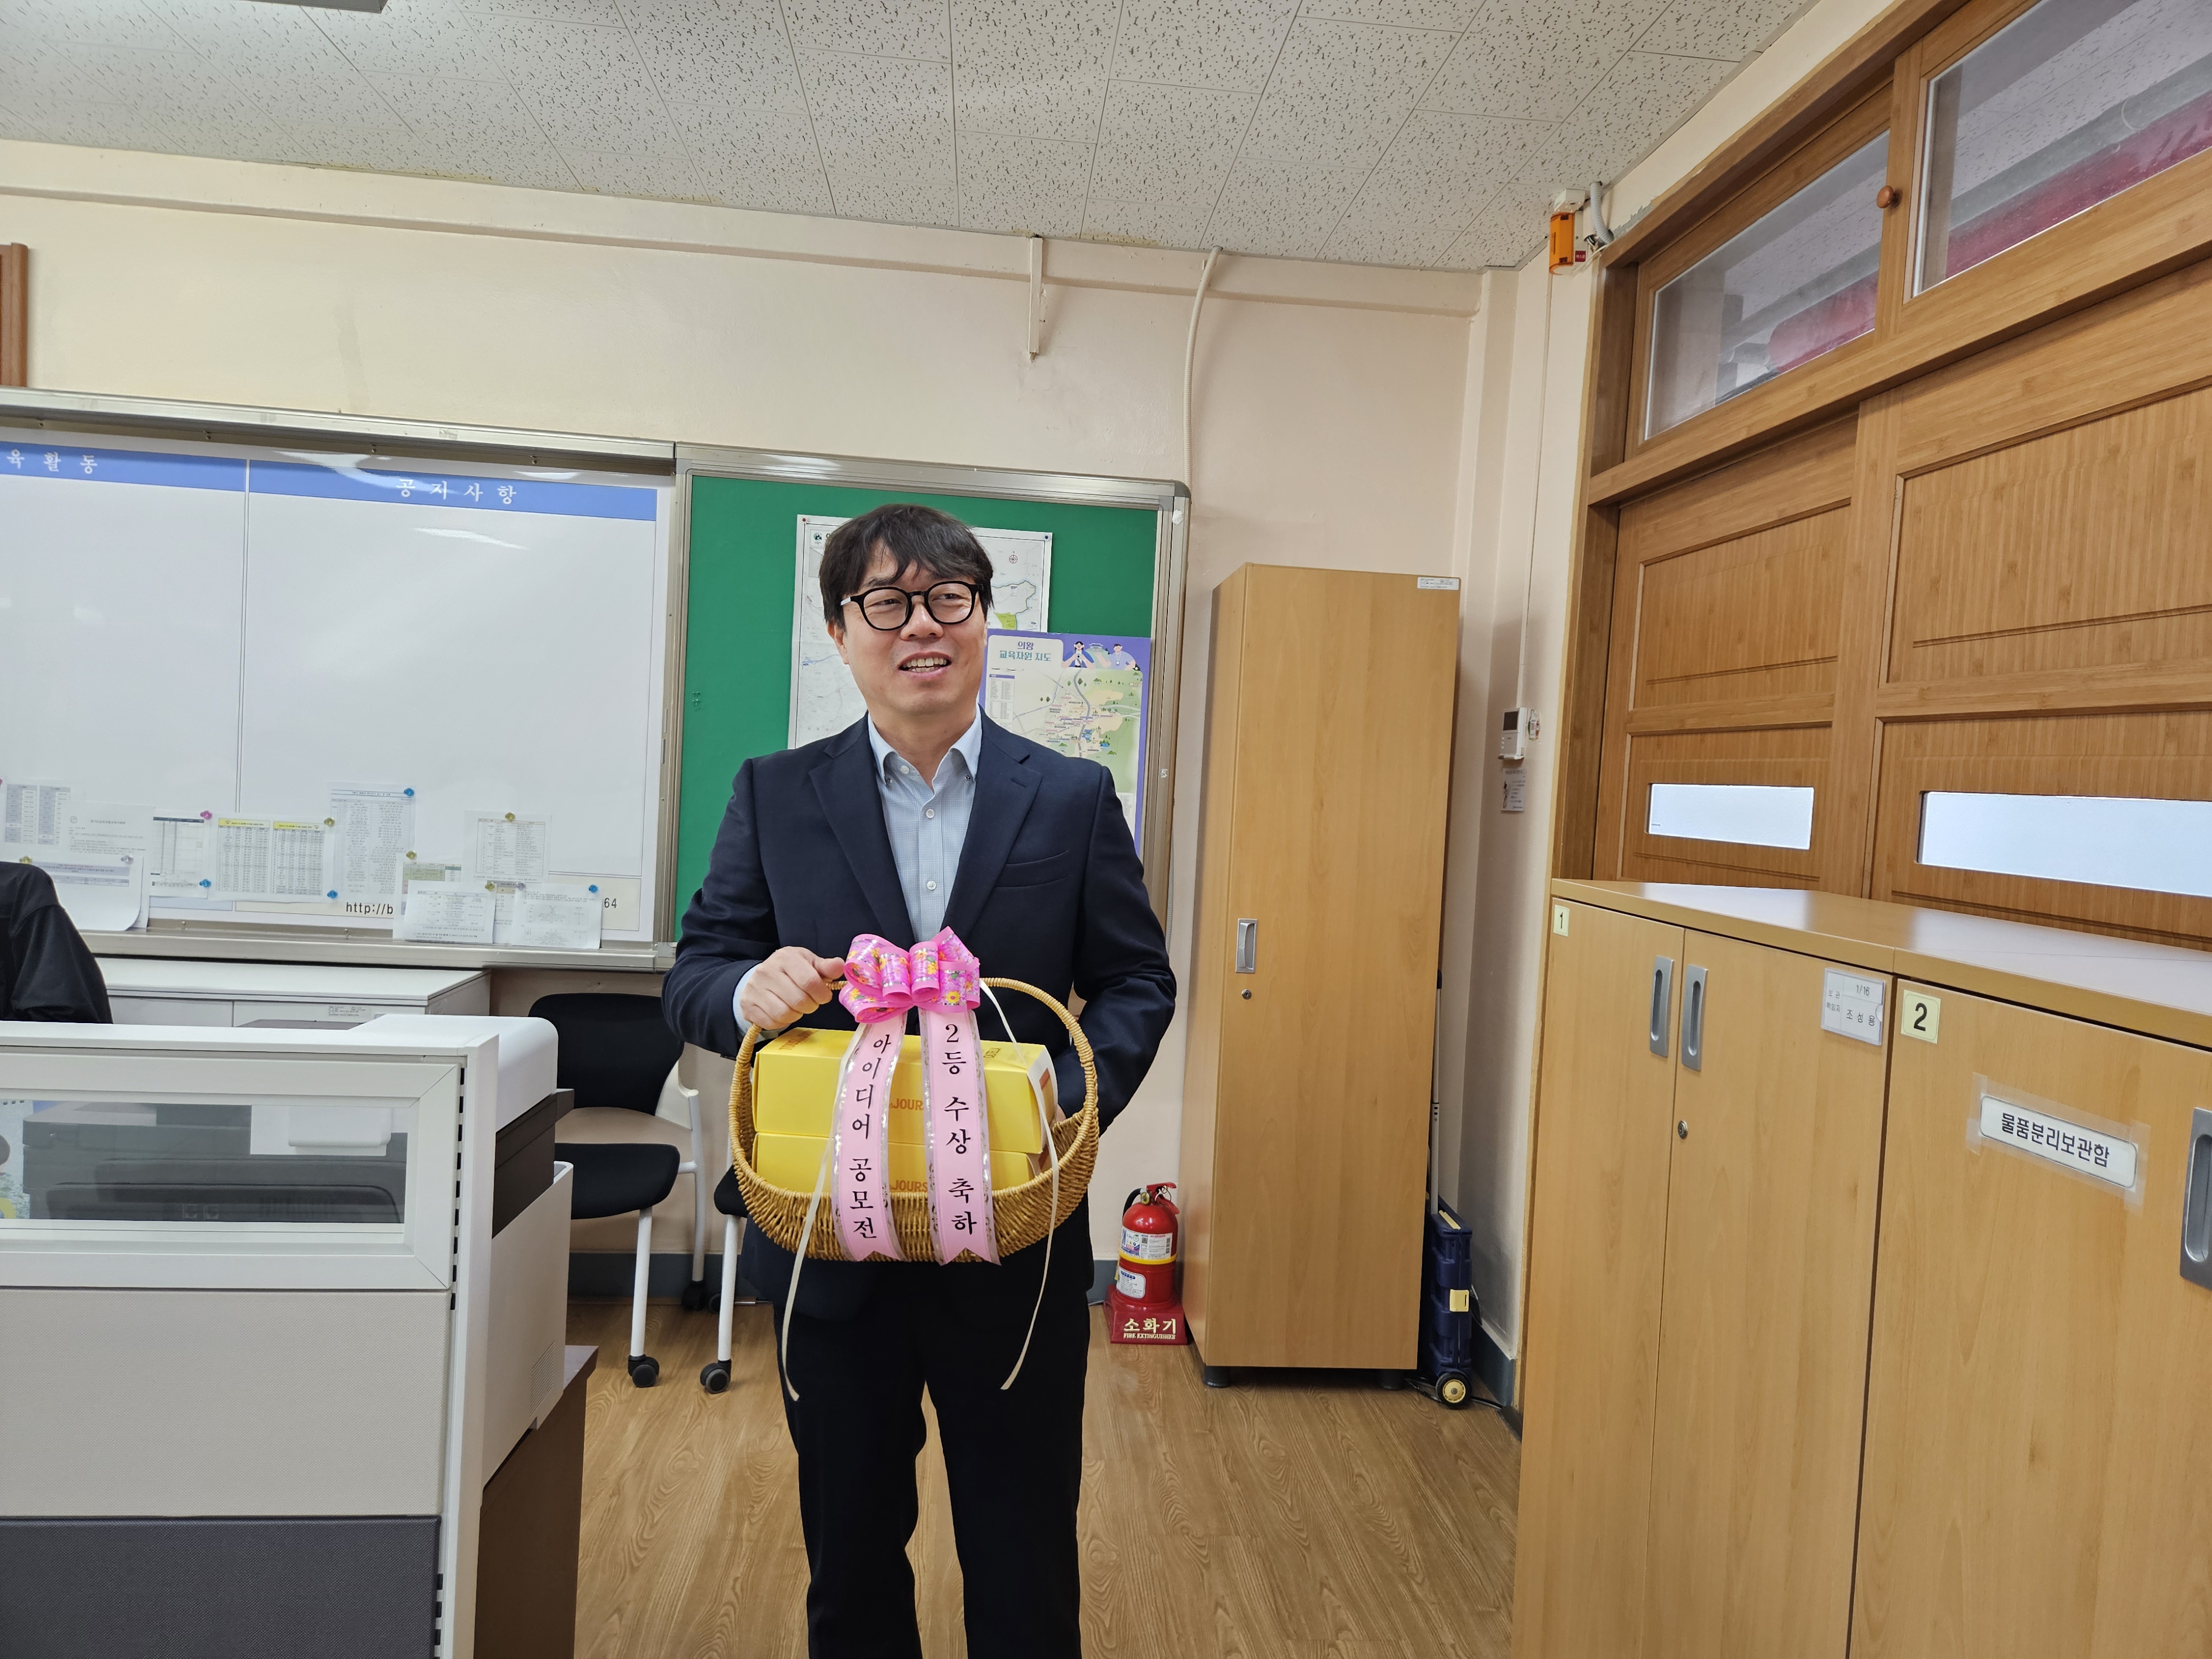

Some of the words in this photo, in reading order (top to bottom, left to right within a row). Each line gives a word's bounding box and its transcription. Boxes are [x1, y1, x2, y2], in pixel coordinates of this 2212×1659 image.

[395, 478, 517, 505] 공지사항
[999, 650, 1032, 661] 교육자원
[1034, 653, 1051, 661] 지도
[1017, 641, 1035, 650] 의왕
[604, 898, 617, 909] 64
[1560, 912, 1563, 929] 1
[1856, 984, 1870, 996] 1/16
[1913, 1002, 1927, 1031] 2
[941, 1023, 967, 1074] 2등
[852, 1034, 891, 1139] 아이디어
[943, 1096, 971, 1155] 수상
[2001, 1112, 2110, 1167] 물품분리보관함
[848, 1157, 878, 1239] 공모전
[948, 1177, 978, 1235] 축하
[1123, 1317, 1176, 1334] 소화기
